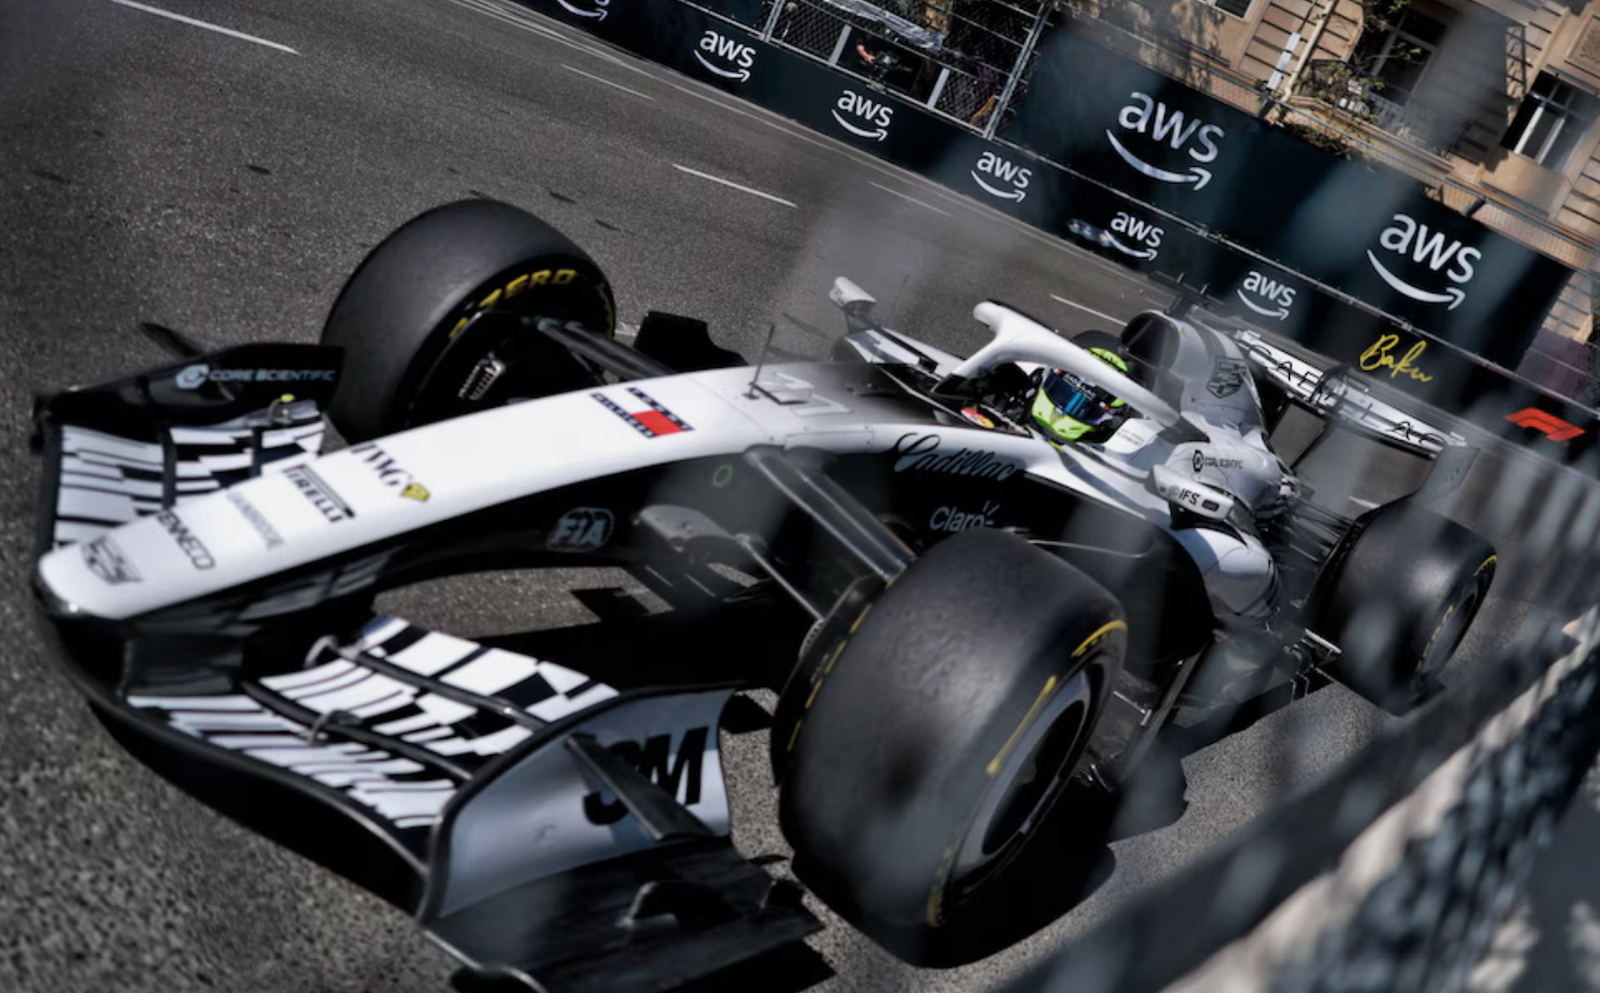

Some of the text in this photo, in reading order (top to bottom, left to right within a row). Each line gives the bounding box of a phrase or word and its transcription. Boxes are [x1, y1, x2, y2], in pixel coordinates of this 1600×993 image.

[699, 29, 757, 69] aws
[836, 89, 894, 128] aws
[1117, 91, 1226, 163] aws
[975, 151, 1033, 189] aws
[1110, 211, 1165, 248] aws
[1379, 213, 1483, 284] aws
[1242, 270, 1297, 308] aws
[1359, 333, 1433, 383] Baku
[893, 432, 1020, 482] Cadillac
[1179, 487, 1200, 506] IFS
